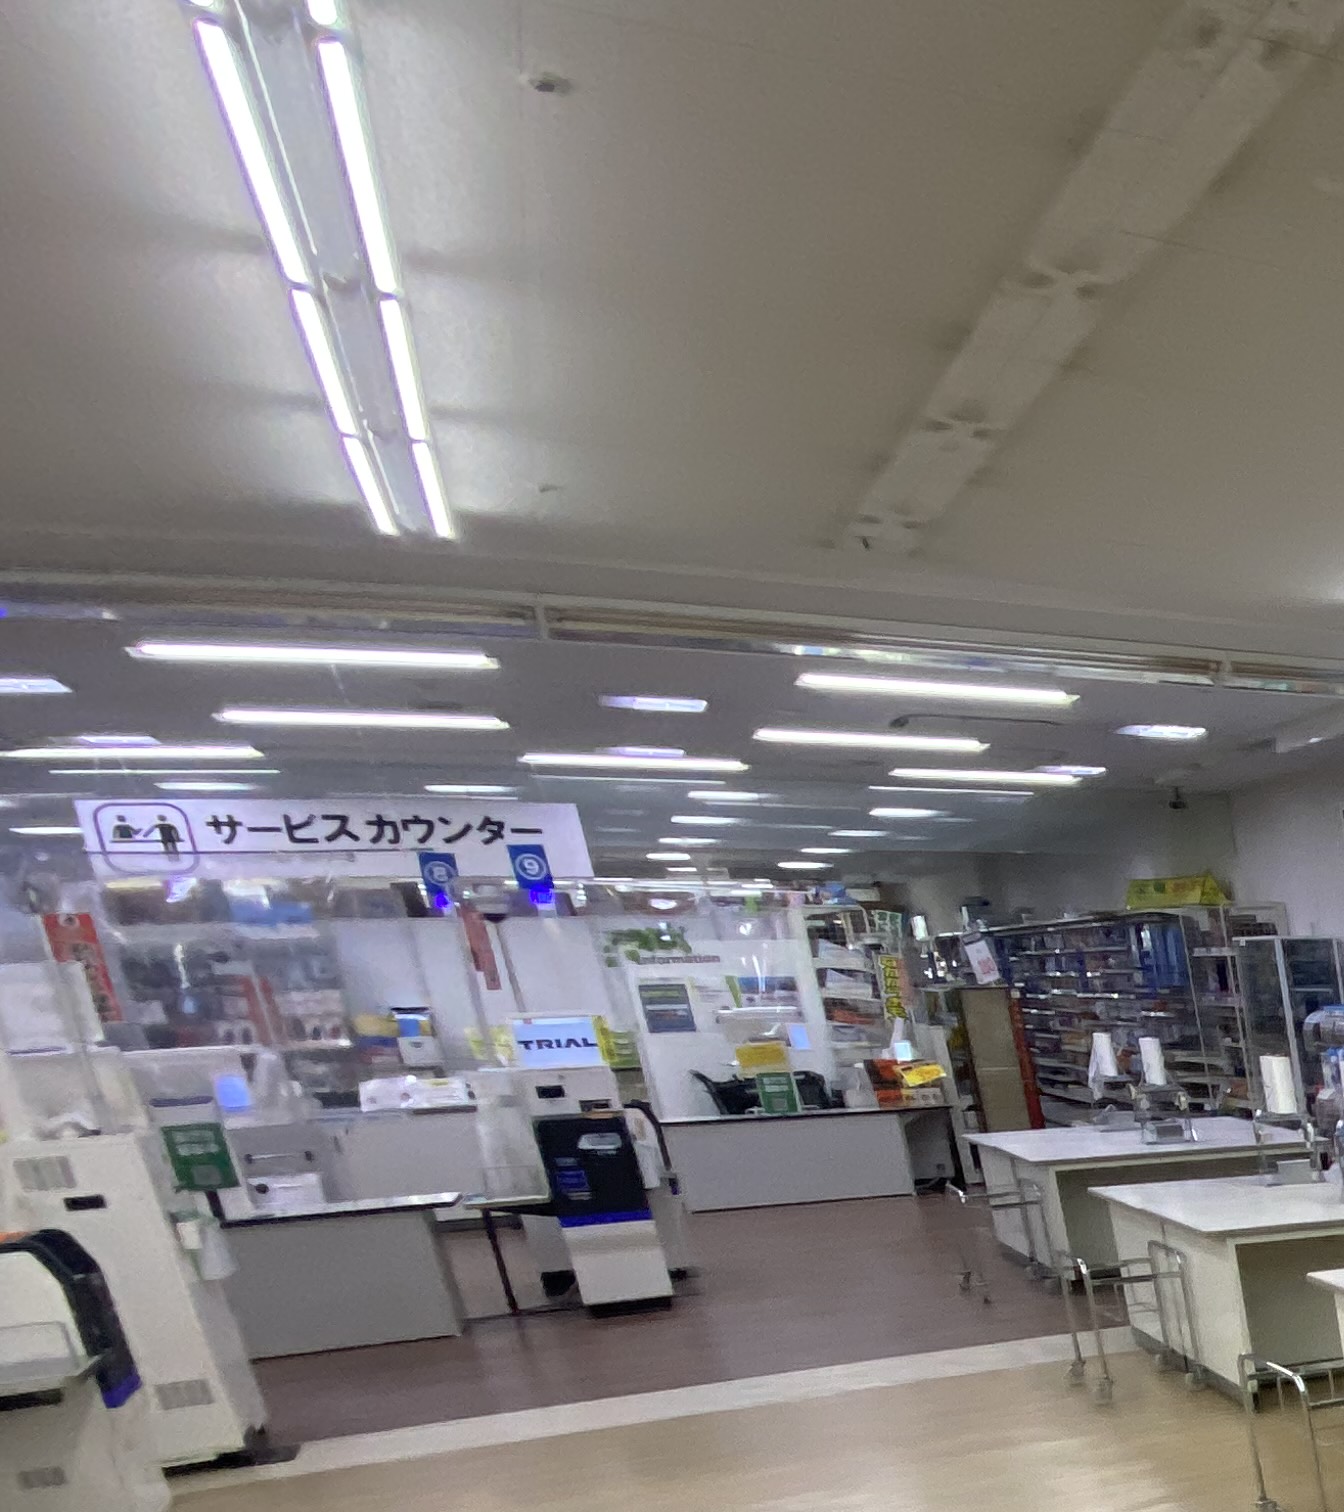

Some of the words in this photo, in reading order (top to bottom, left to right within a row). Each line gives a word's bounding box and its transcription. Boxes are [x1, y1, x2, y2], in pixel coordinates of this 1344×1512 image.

[205, 813, 544, 846] サービスカウンター
[517, 1037, 600, 1051] TRIAL
